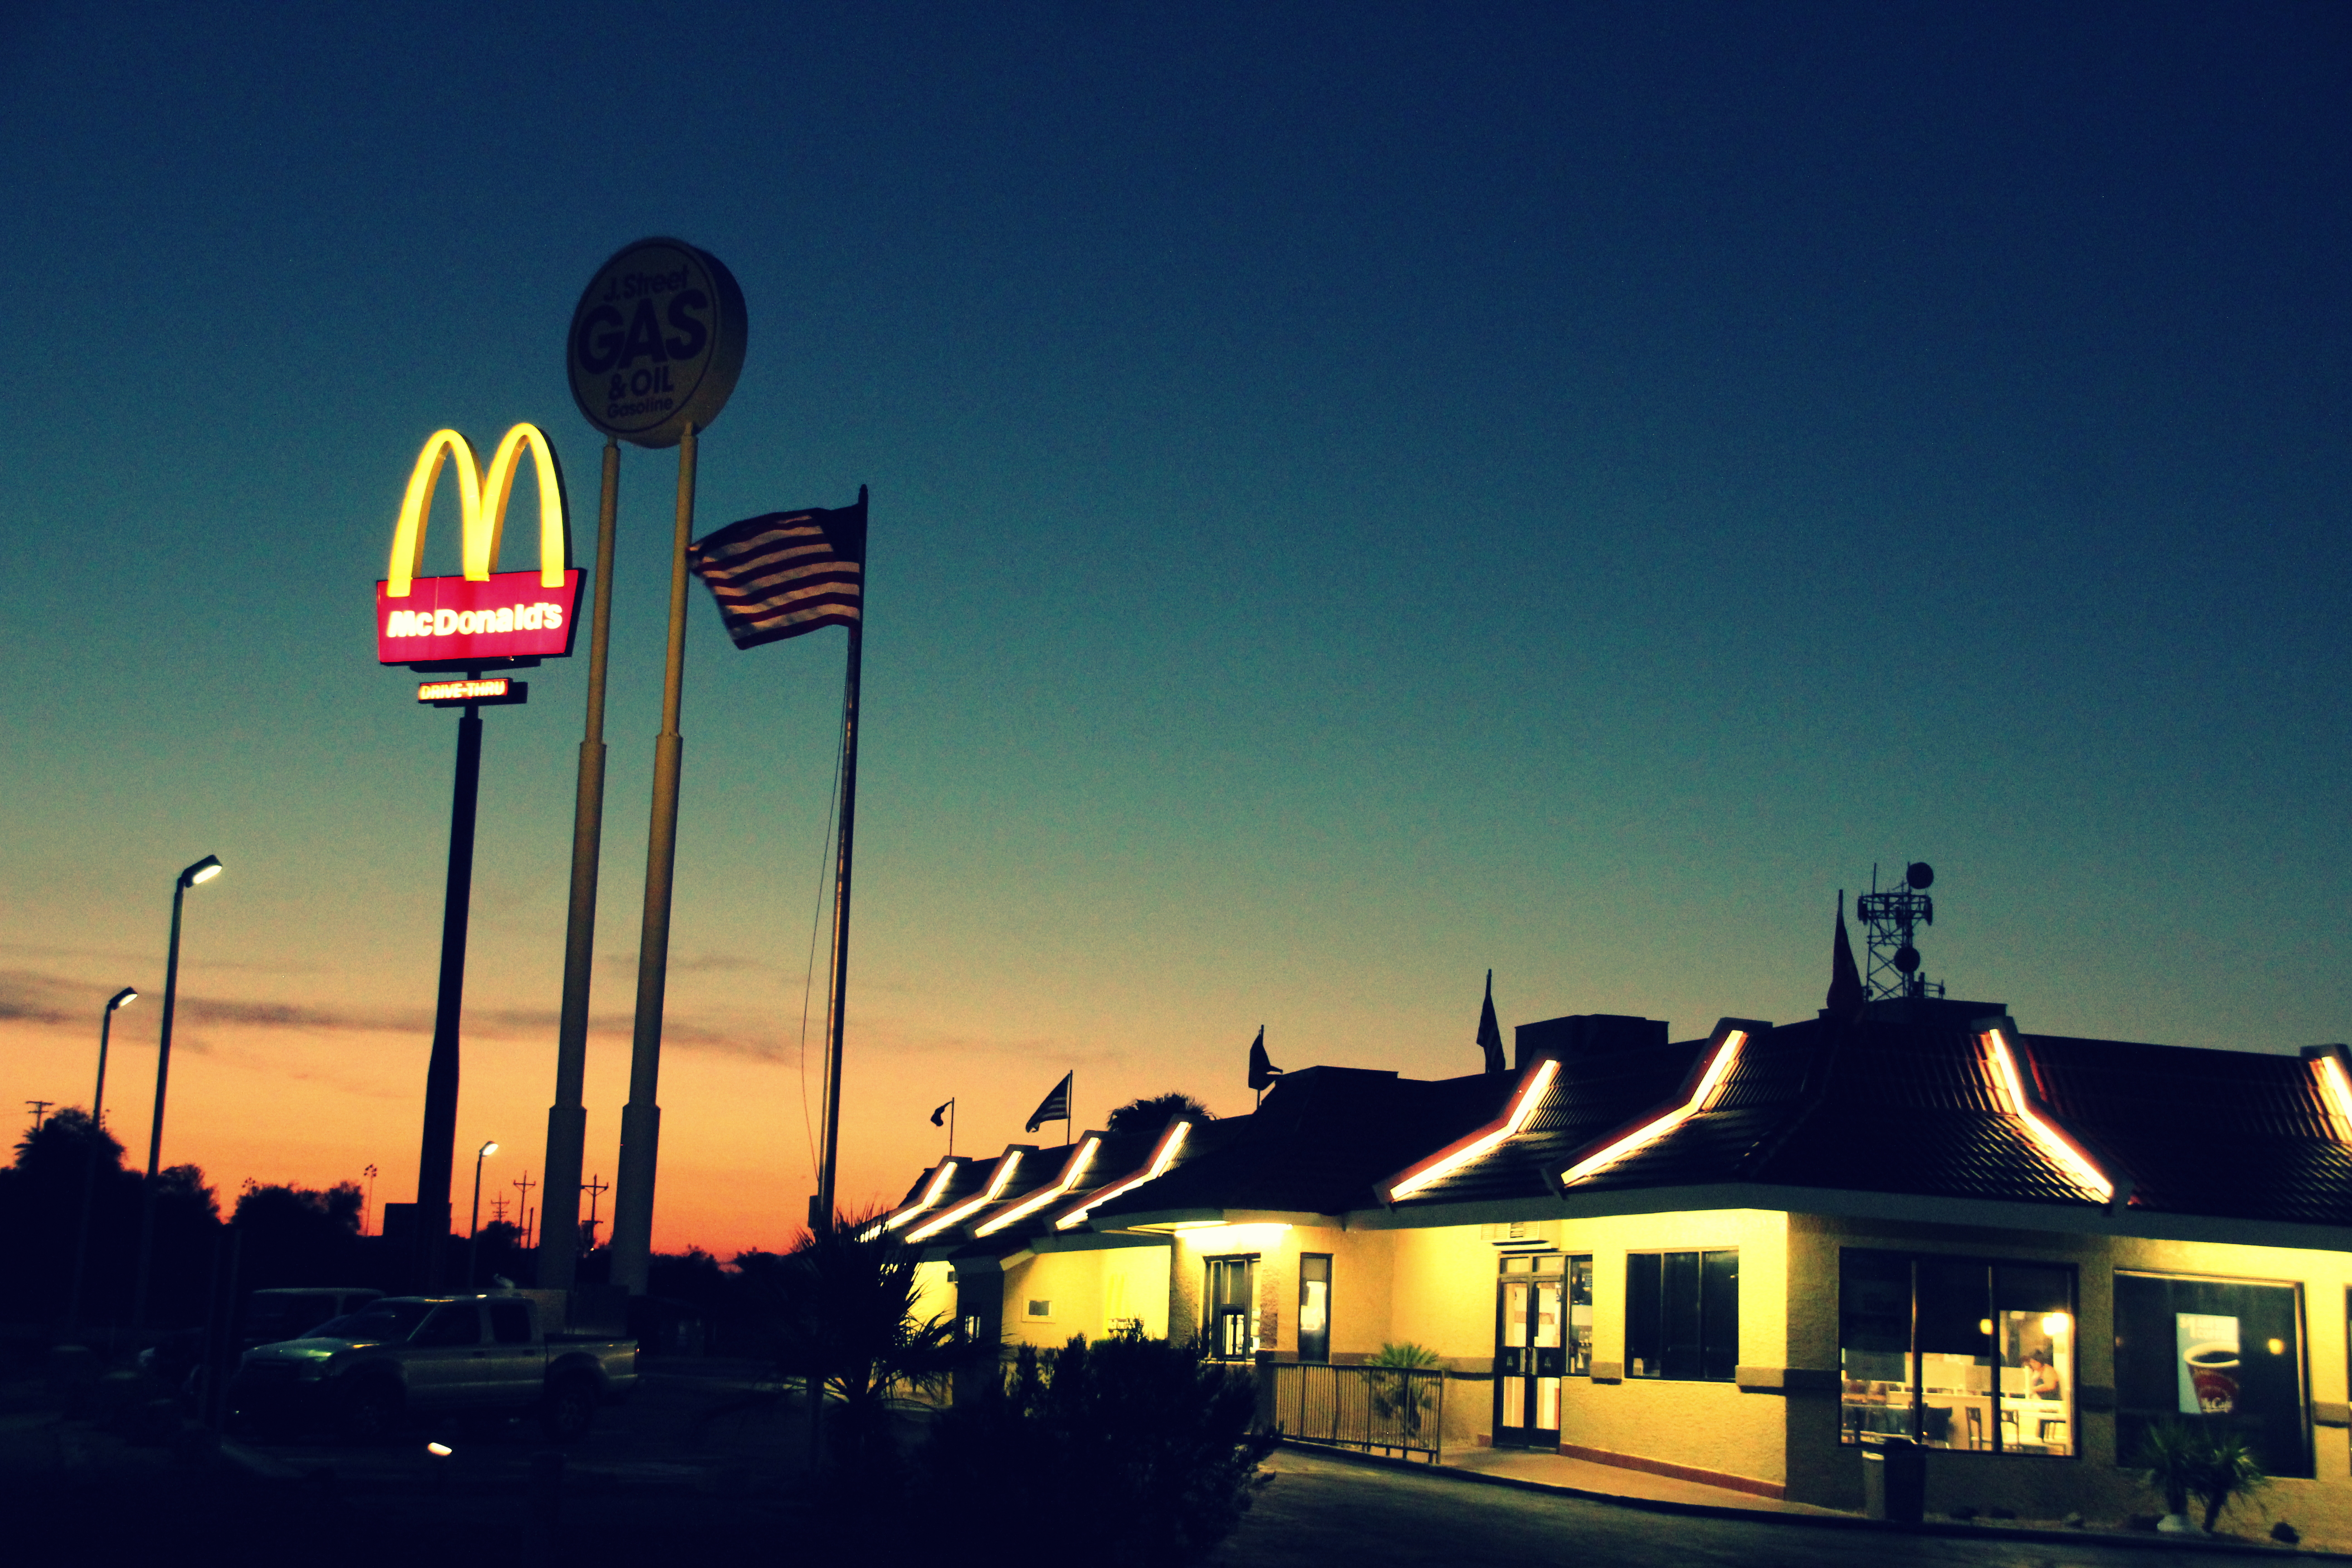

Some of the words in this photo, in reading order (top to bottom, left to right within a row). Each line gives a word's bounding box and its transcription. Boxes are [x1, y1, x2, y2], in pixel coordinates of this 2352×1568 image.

[623, 265, 689, 299] Street
[578, 289, 708, 374] GAS
[609, 373, 627, 401] &
[631, 366, 674, 396] OIL
[608, 398, 674, 418] Gasoline
[387, 602, 563, 637] McDonald's
[419, 681, 505, 699] DRIVE-THRU
